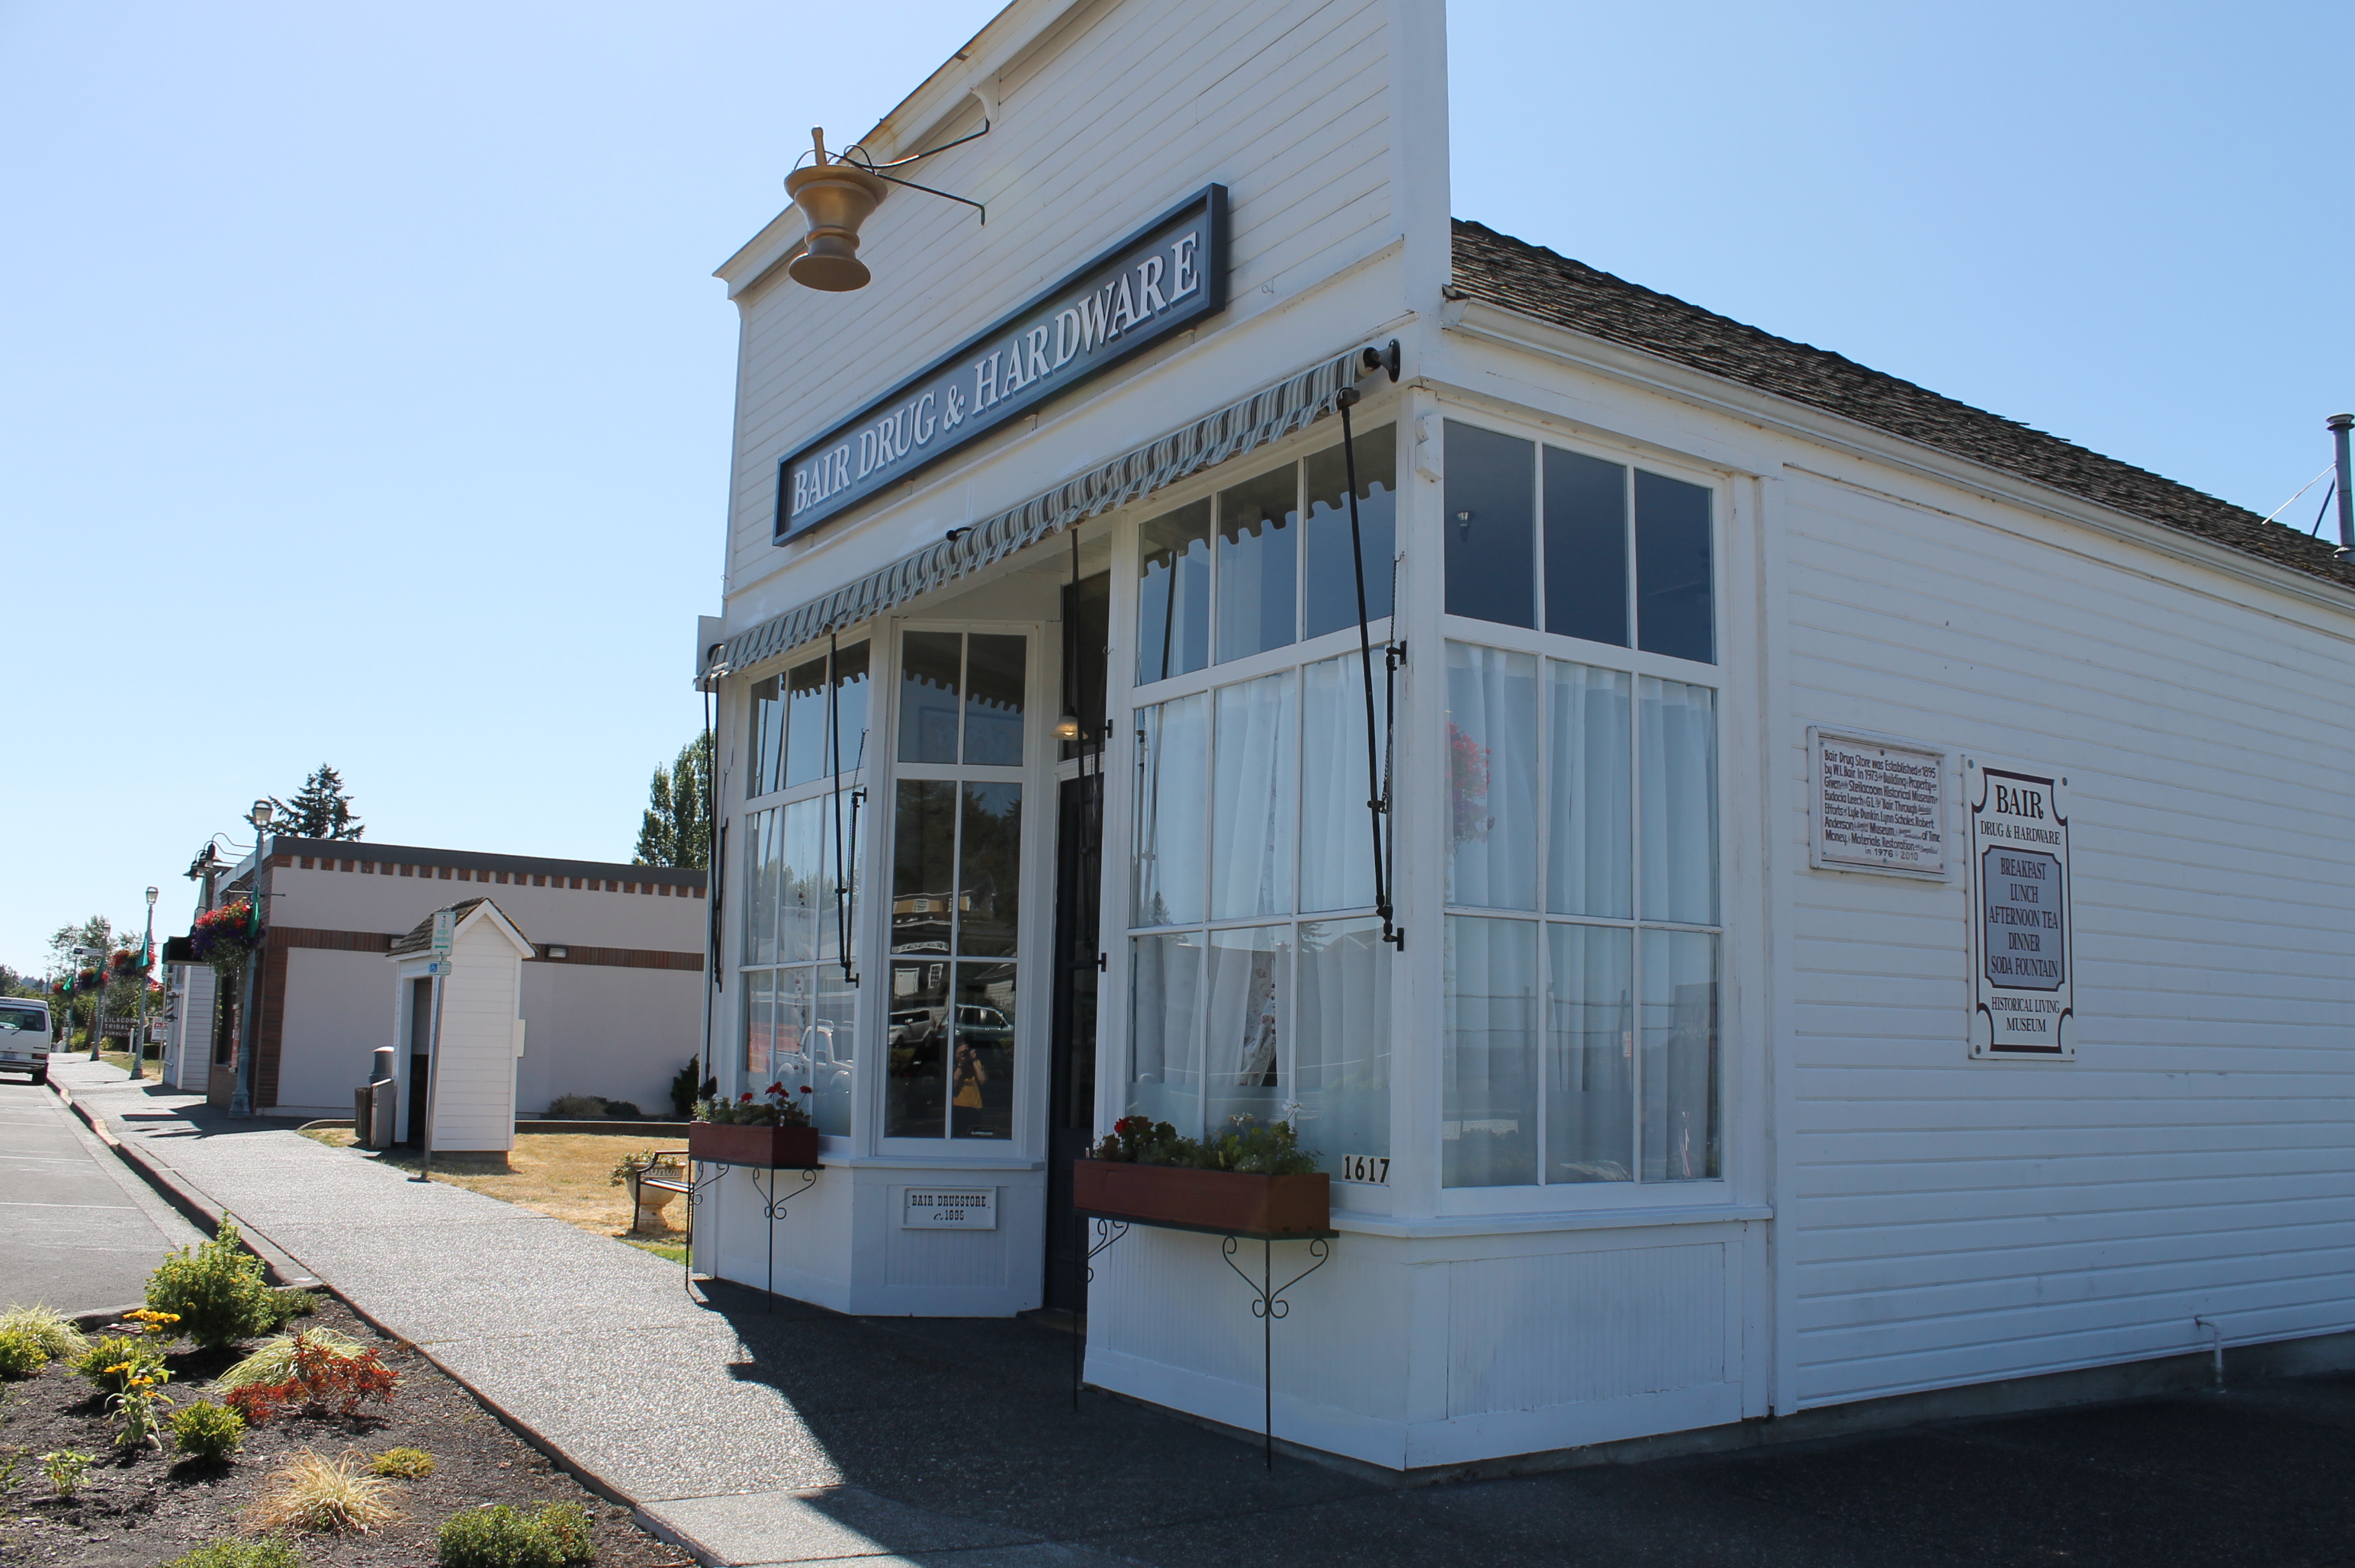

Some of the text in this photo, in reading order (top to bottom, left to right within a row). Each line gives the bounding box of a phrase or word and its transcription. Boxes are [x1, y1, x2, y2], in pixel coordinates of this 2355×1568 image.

[792, 231, 1199, 517] BAIR DRUG & HARDWARE
[1824, 750, 1837, 763] Bair
[1839, 753, 1854, 767] Drug
[1855, 755, 1871, 767] Store
[1871, 760, 1883, 770] was
[1884, 760, 1917, 776] Established
[1922, 766, 1936, 779] 1895
[1824, 763, 1832, 776] by
[1858, 769, 1863, 779] In
[1864, 770, 1878, 782] 1973
[1883, 773, 1906, 787] Building
[1908, 777, 1931, 792] Property
[1824, 777, 1840, 790] Given
[1849, 781, 1883, 796] Steilacoom
[1884, 787, 1910, 800] Historical
[1912, 791, 1935, 804] Museum
[1995, 784, 2044, 820] BAIR
[1824, 791, 1847, 803] Eudocia
[1848, 794, 1863, 805] Leech
[1894, 802, 1917, 815] Through
[1824, 804, 1843, 816] Efforts
[1848, 807, 1859, 820] Lyle
[1881, 812, 1894, 824] Lynn
[1915, 817, 1934, 828] Robert
[1825, 818, 1854, 831] Anderson
[1921, 831, 1928, 840] of
[1980, 821, 2061, 845] DRUG & HARDWARE
[1875, 849, 1893, 857] 1976
[1900, 851, 1918, 861] 2010
[1882, 837, 1914, 851] Restoration
[2000, 857, 2047, 880] BREAKFAST
[2010, 884, 2039, 904] LUNCH
[442, 920, 446, 928] 2
[1988, 906, 2058, 930] AFTERNOON TEA
[2008, 932, 2040, 952] DINNER
[1990, 956, 2058, 978] SODA FOUNTAIN
[1990, 996, 2060, 1014] HISTORICAL LIVING
[2006, 1017, 2046, 1033] MUSEUM
[1345, 1155, 1390, 1184] 1617
[911, 1194, 987, 1207] BAIR DRUGSTORE
